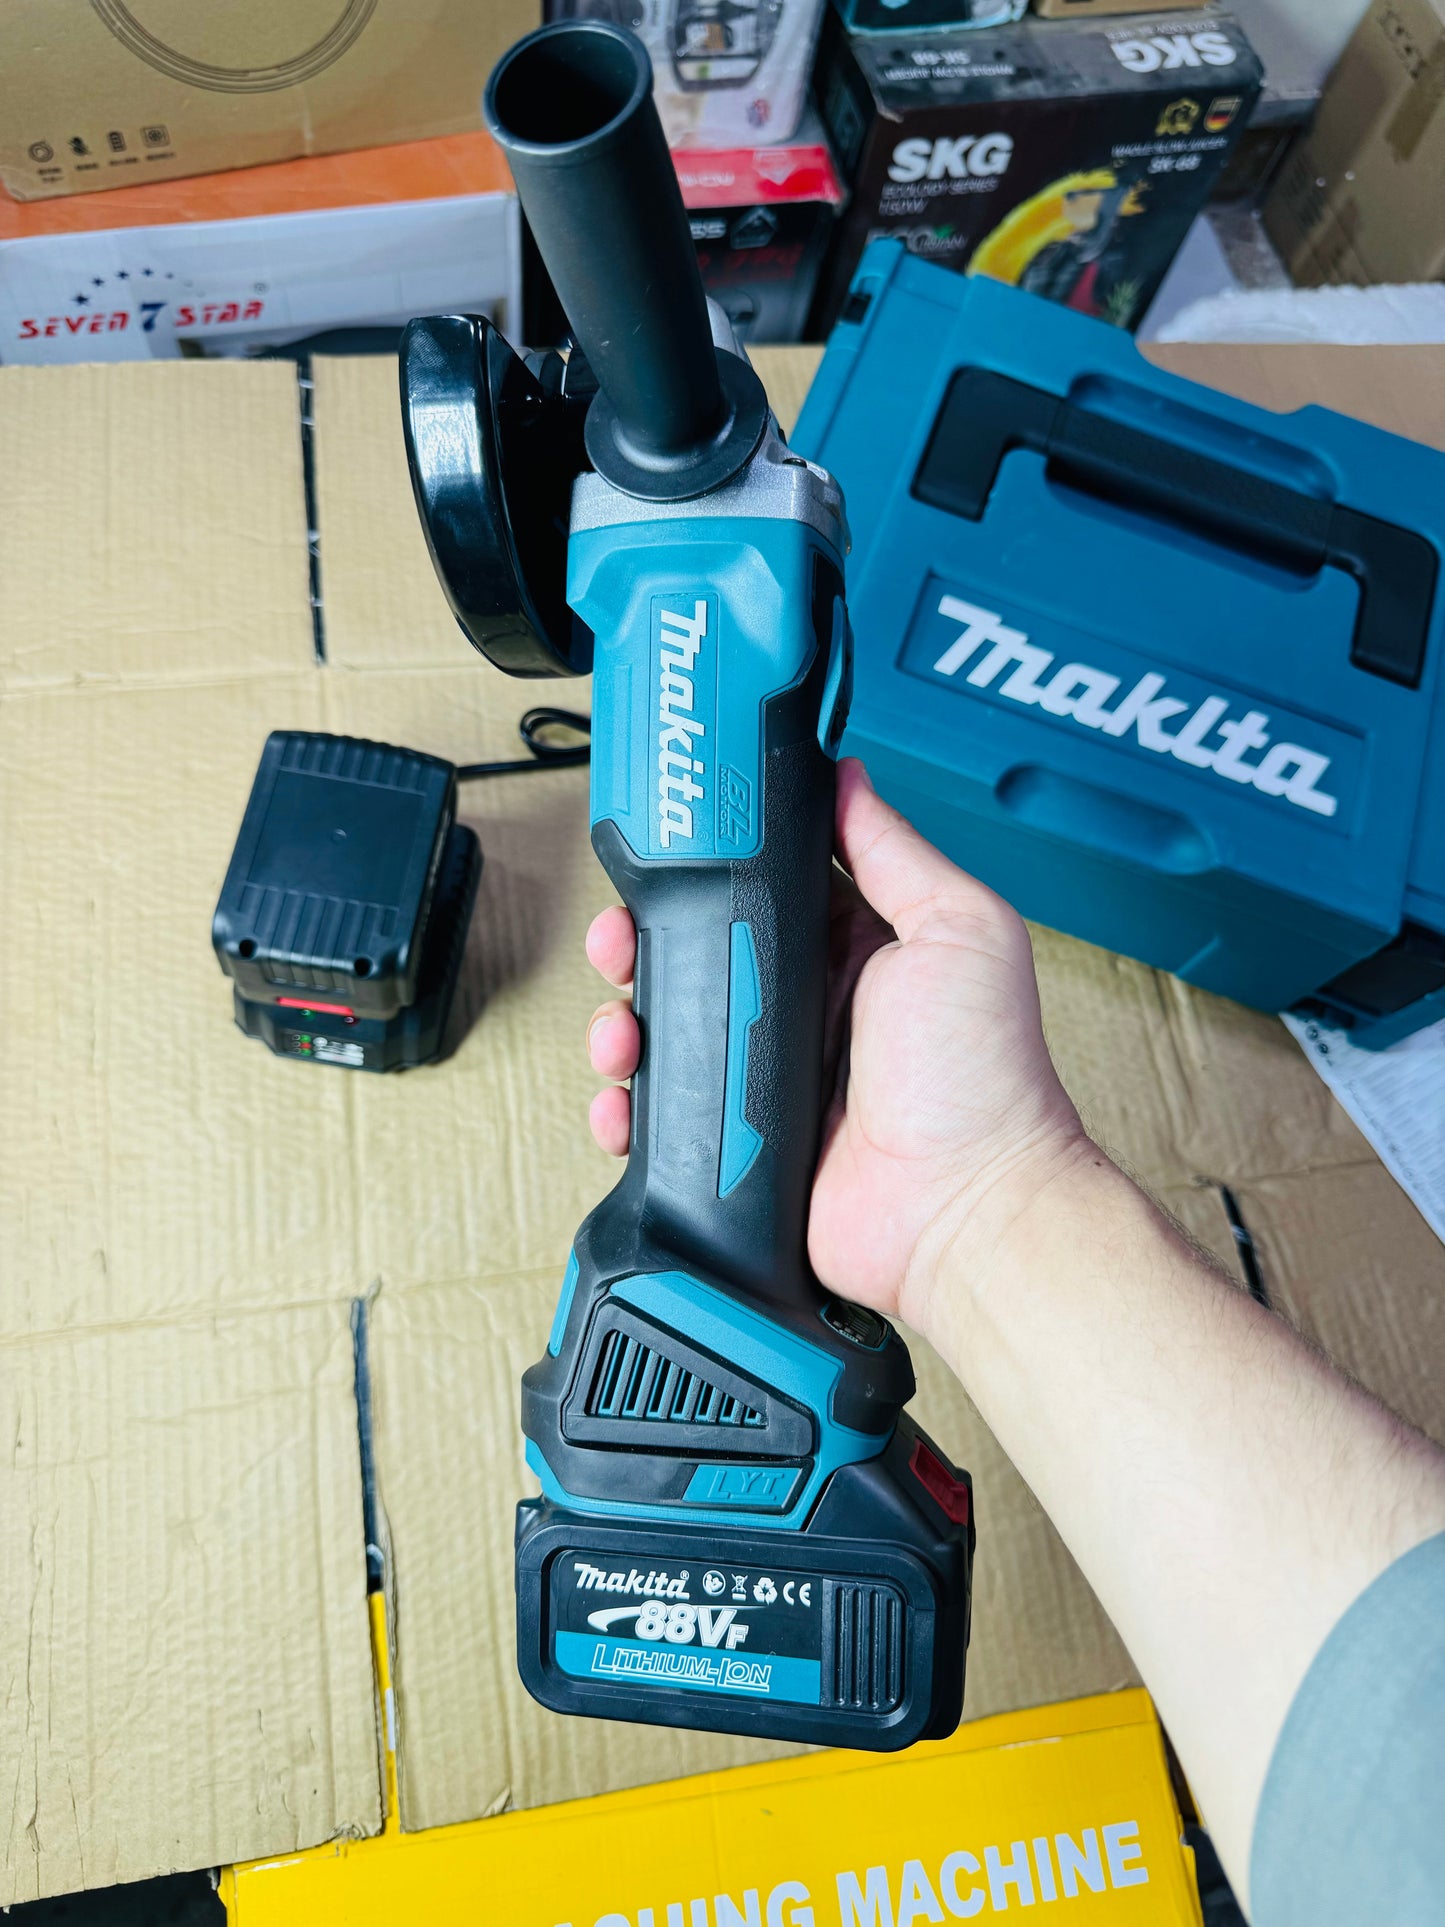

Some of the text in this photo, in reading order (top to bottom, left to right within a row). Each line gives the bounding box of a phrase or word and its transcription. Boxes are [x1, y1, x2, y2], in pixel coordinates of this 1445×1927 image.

[1112, 31, 1237, 73] SKG
[887, 131, 1014, 183] SKG
[19, 300, 264, 339] SEVEN 7 STAR
[706, 1470, 785, 1500] LYT
[591, 1644, 772, 1693] LITHIUM-ION
[835, 1820, 1149, 1927] MACHINE
